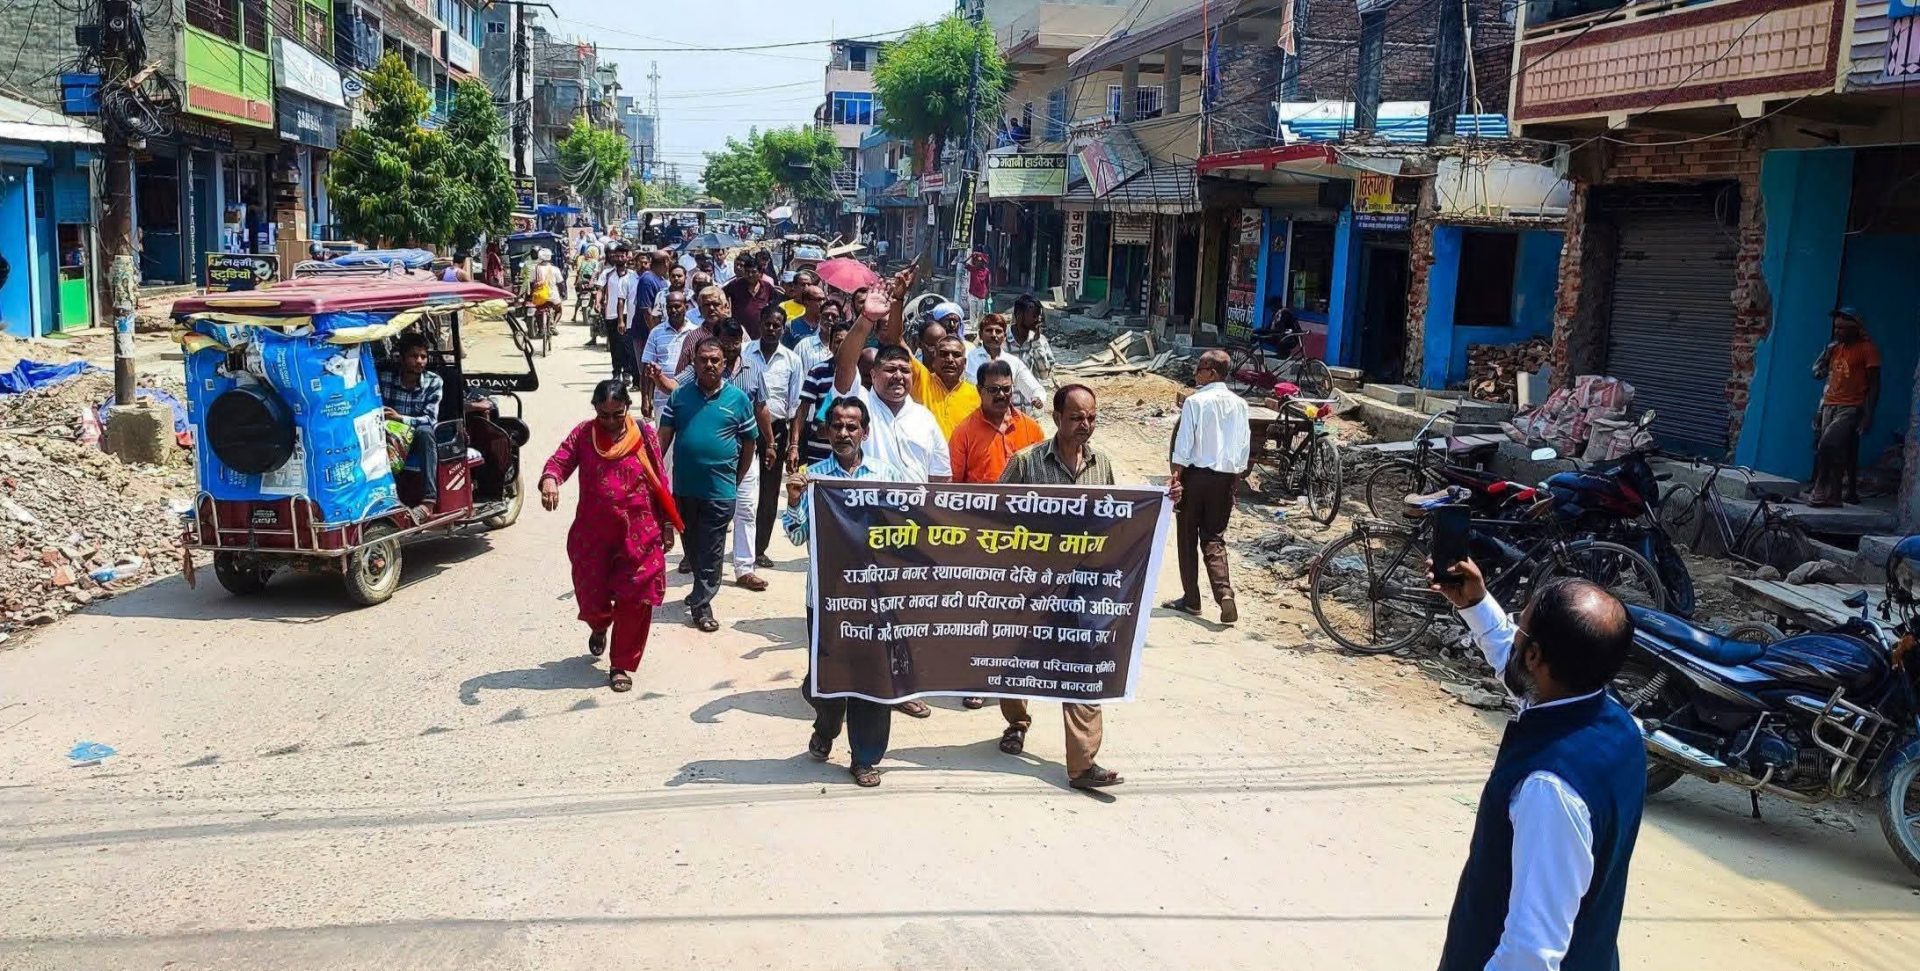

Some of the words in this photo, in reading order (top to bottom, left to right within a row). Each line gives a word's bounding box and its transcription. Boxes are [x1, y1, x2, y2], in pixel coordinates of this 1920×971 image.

[843, 488, 879, 507] अब
[886, 485, 929, 511] कुनै
[934, 491, 999, 511] बहाना
[1006, 491, 1088, 516] स्वीकार्य
[1094, 494, 1134, 518] छैन
[868, 519, 920, 549] हाम्रो
[928, 526, 970, 546] एक
[976, 525, 1052, 554] सुत्रीय
[1059, 530, 1108, 554] मांग
[843, 564, 899, 583] राजविराज
[902, 566, 929, 581] नगर
[933, 565, 1007, 582] स्थापनाकाल
[1010, 564, 1037, 584] देखि
[1041, 570, 1053, 585] नै
[825, 597, 867, 612] आएका
[909, 594, 938, 609] भन्दा
[941, 591, 964, 608] बढी
[967, 591, 1026, 611] परिवारको
[1030, 595, 1086, 613] खोसिएको
[840, 621, 873, 640] फिर्ता
[932, 620, 988, 638] जग्गाधनी
[1057, 627, 1092, 643] प्रदान
[970, 656, 1039, 669] जनआन्दोलन
[1043, 658, 1093, 674] परिचालन
[1005, 675, 1057, 690] राजविराज
